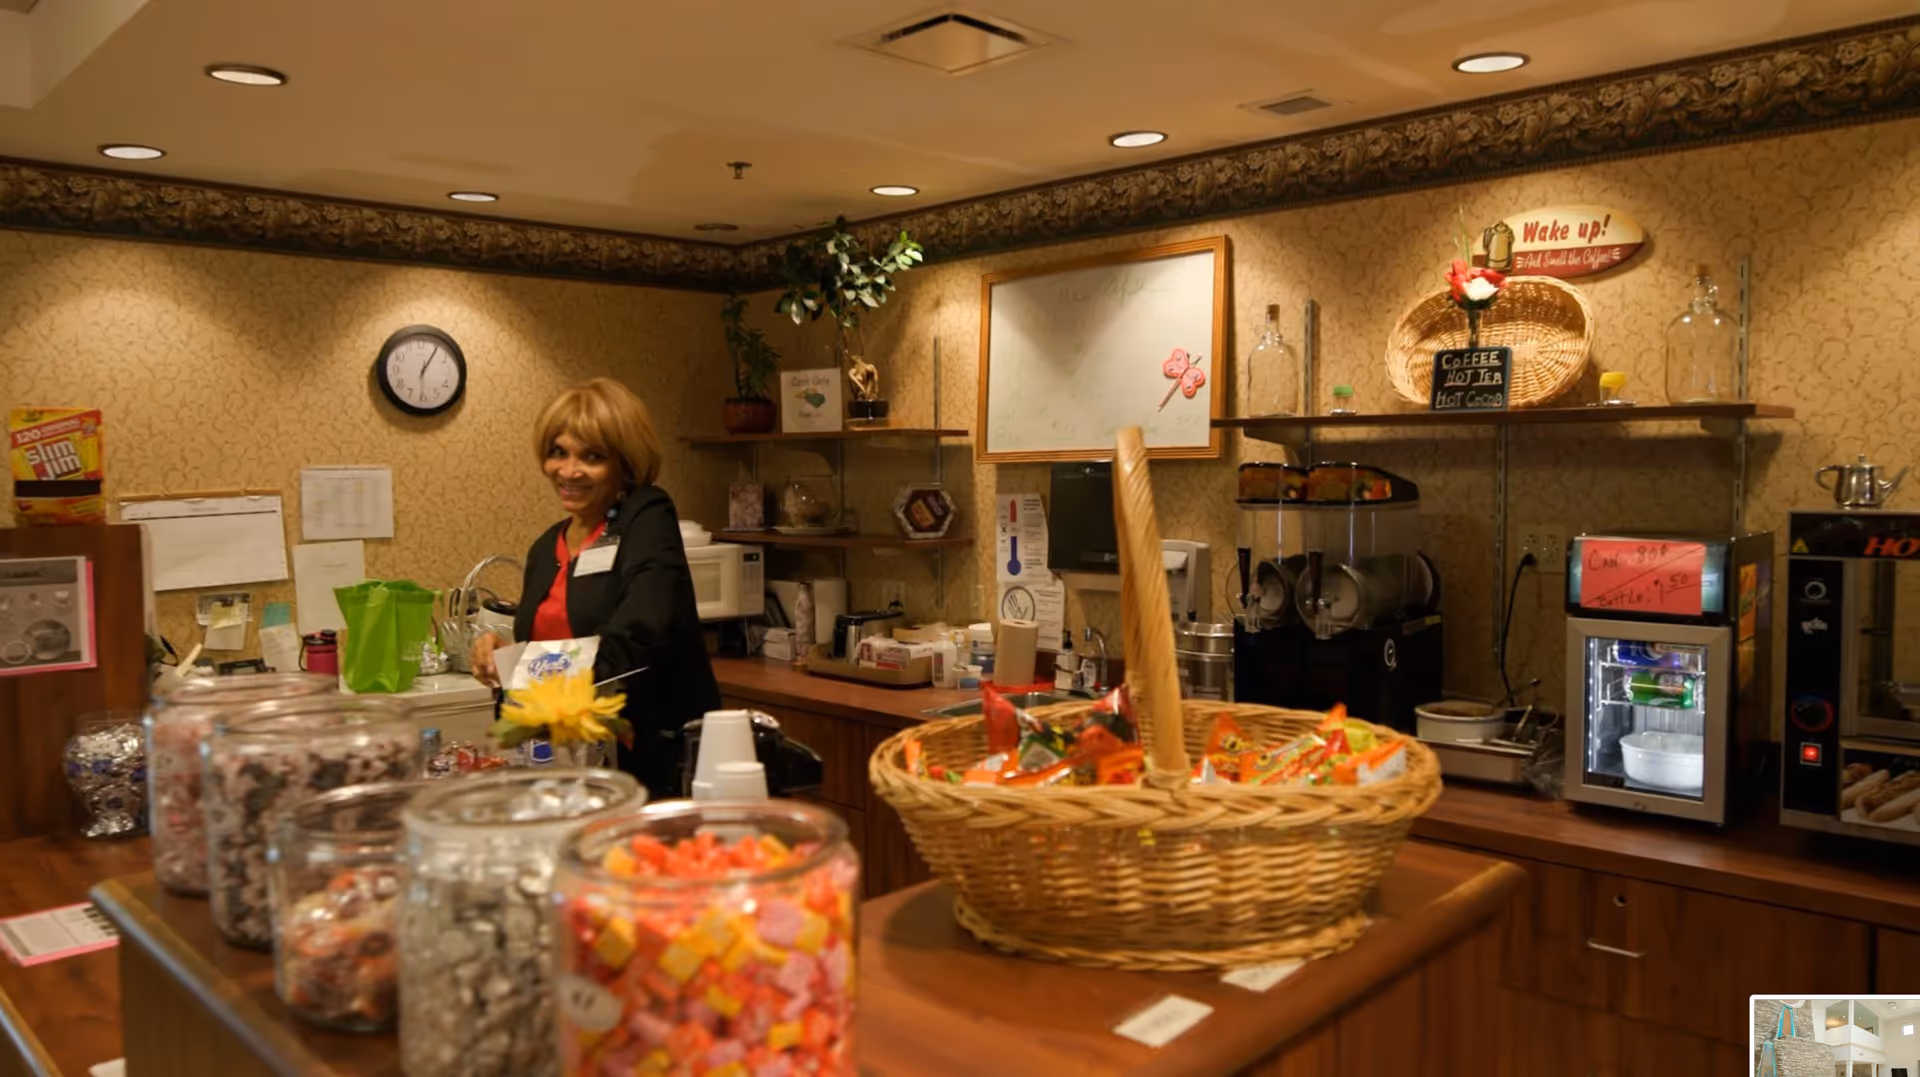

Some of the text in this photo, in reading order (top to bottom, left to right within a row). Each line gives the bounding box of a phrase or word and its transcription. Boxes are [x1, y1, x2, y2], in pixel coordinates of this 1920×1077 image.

[1523, 213, 1611, 244] Wake up!
[1543, 250, 1567, 268] Smell
[1568, 249, 1581, 266] the
[1446, 370, 1474, 386] HOT
[17, 429, 41, 444] 120
